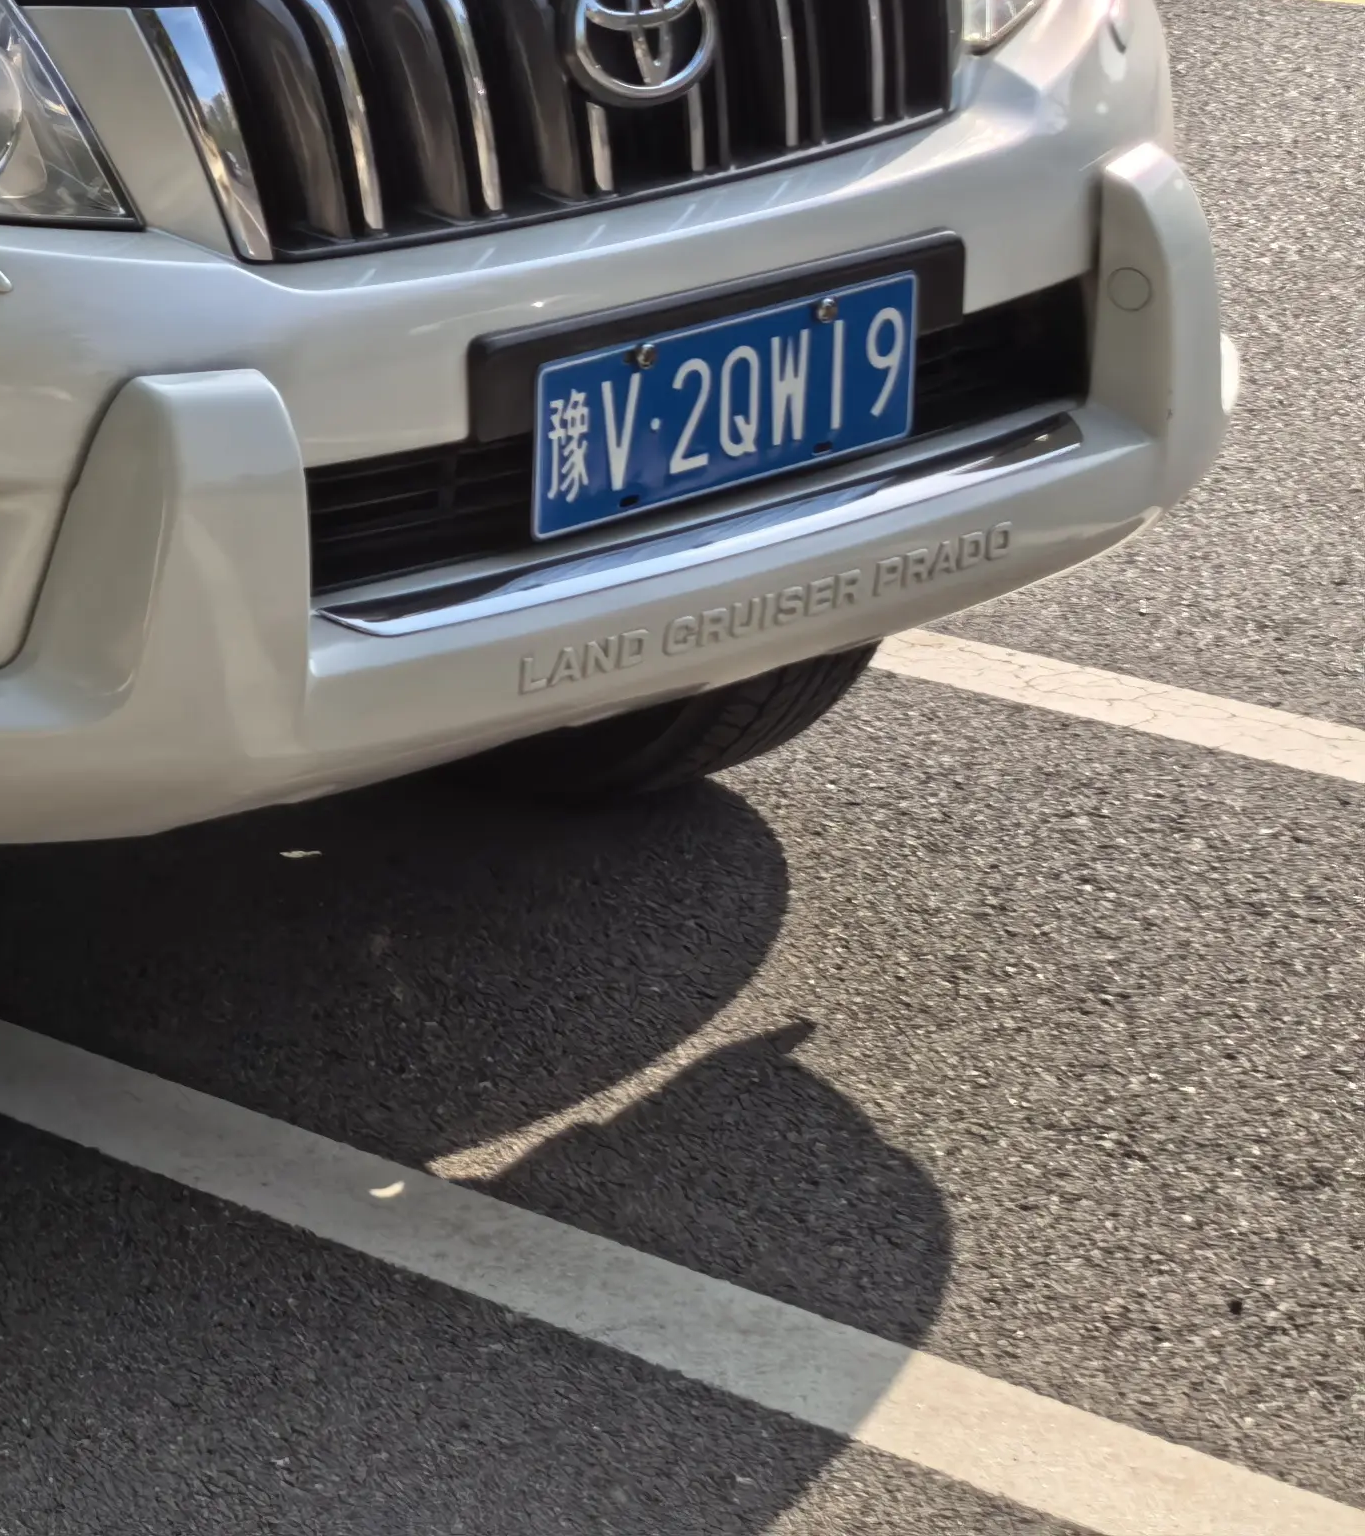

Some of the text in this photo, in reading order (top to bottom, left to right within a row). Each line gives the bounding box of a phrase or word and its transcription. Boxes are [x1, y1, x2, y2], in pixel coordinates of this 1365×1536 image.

[517, 520, 1013, 696] LAND CRUISER PRADO
